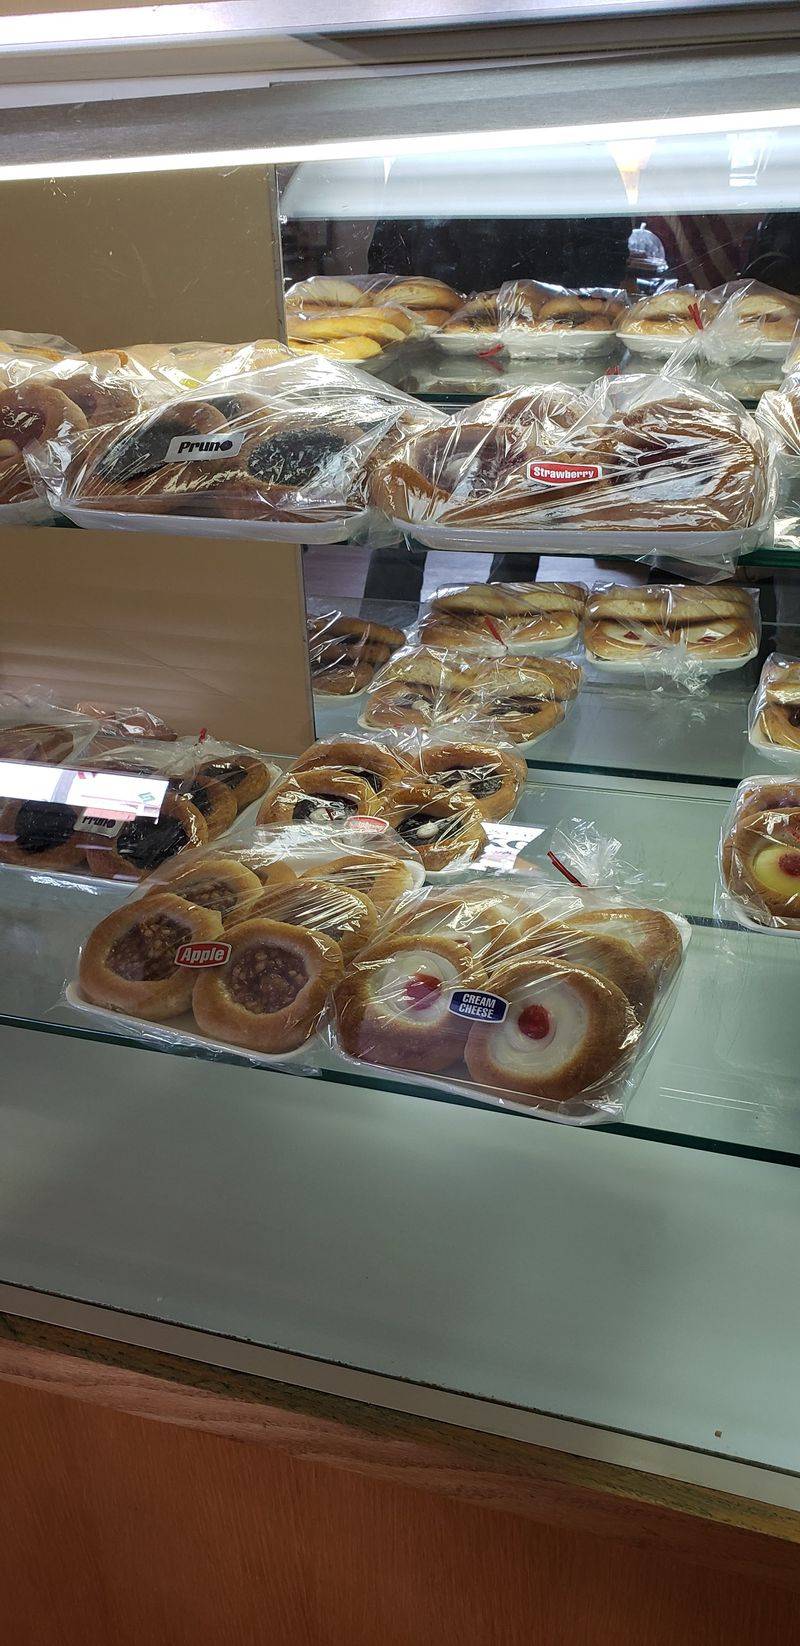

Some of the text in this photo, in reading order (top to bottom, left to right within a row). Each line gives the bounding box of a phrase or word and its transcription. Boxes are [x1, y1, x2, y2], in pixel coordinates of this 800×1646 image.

[533, 466, 595, 479] Strawberry
[179, 947, 225, 964] Apple
[462, 993, 497, 1009] CREAM
[458, 1003, 495, 1019] CHEESE
